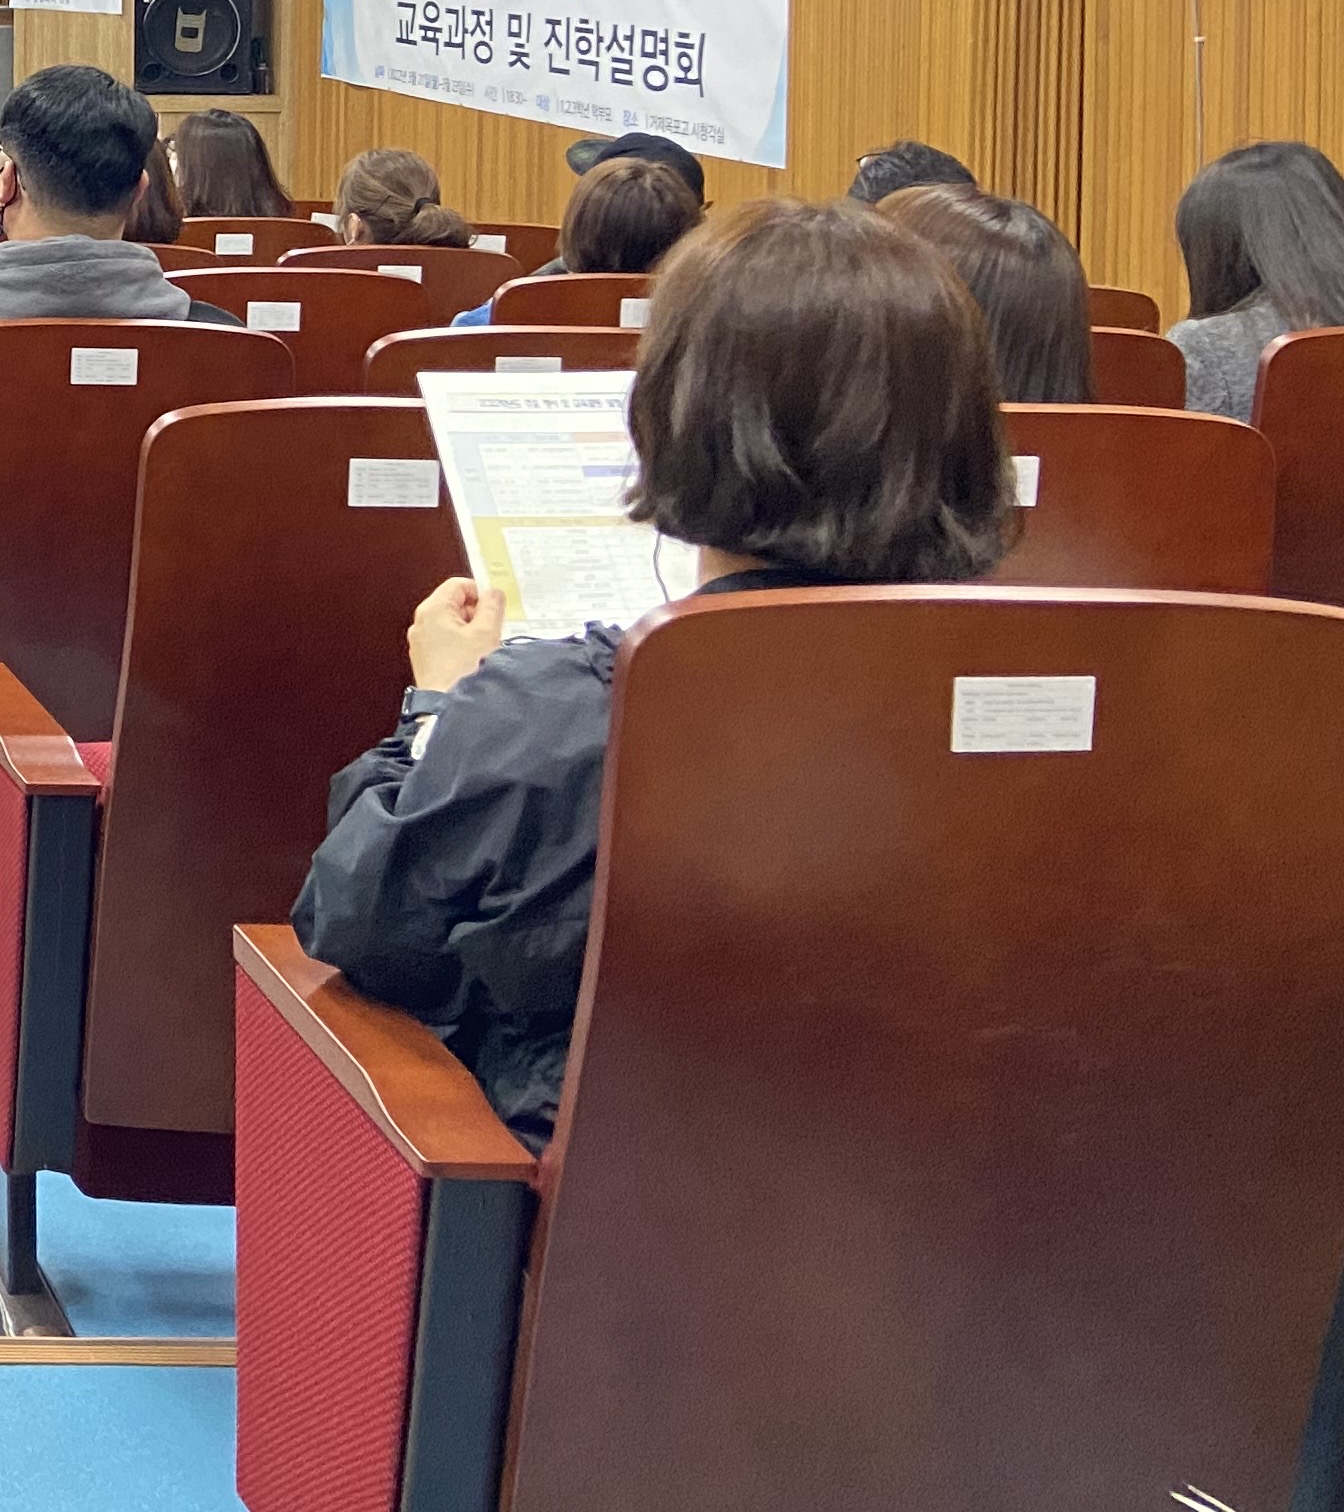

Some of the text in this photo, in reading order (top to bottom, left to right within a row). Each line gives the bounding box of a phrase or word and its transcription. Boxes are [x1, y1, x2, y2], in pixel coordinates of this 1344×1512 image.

[395, 0, 706, 98] 교육과정 및 진학설명회
